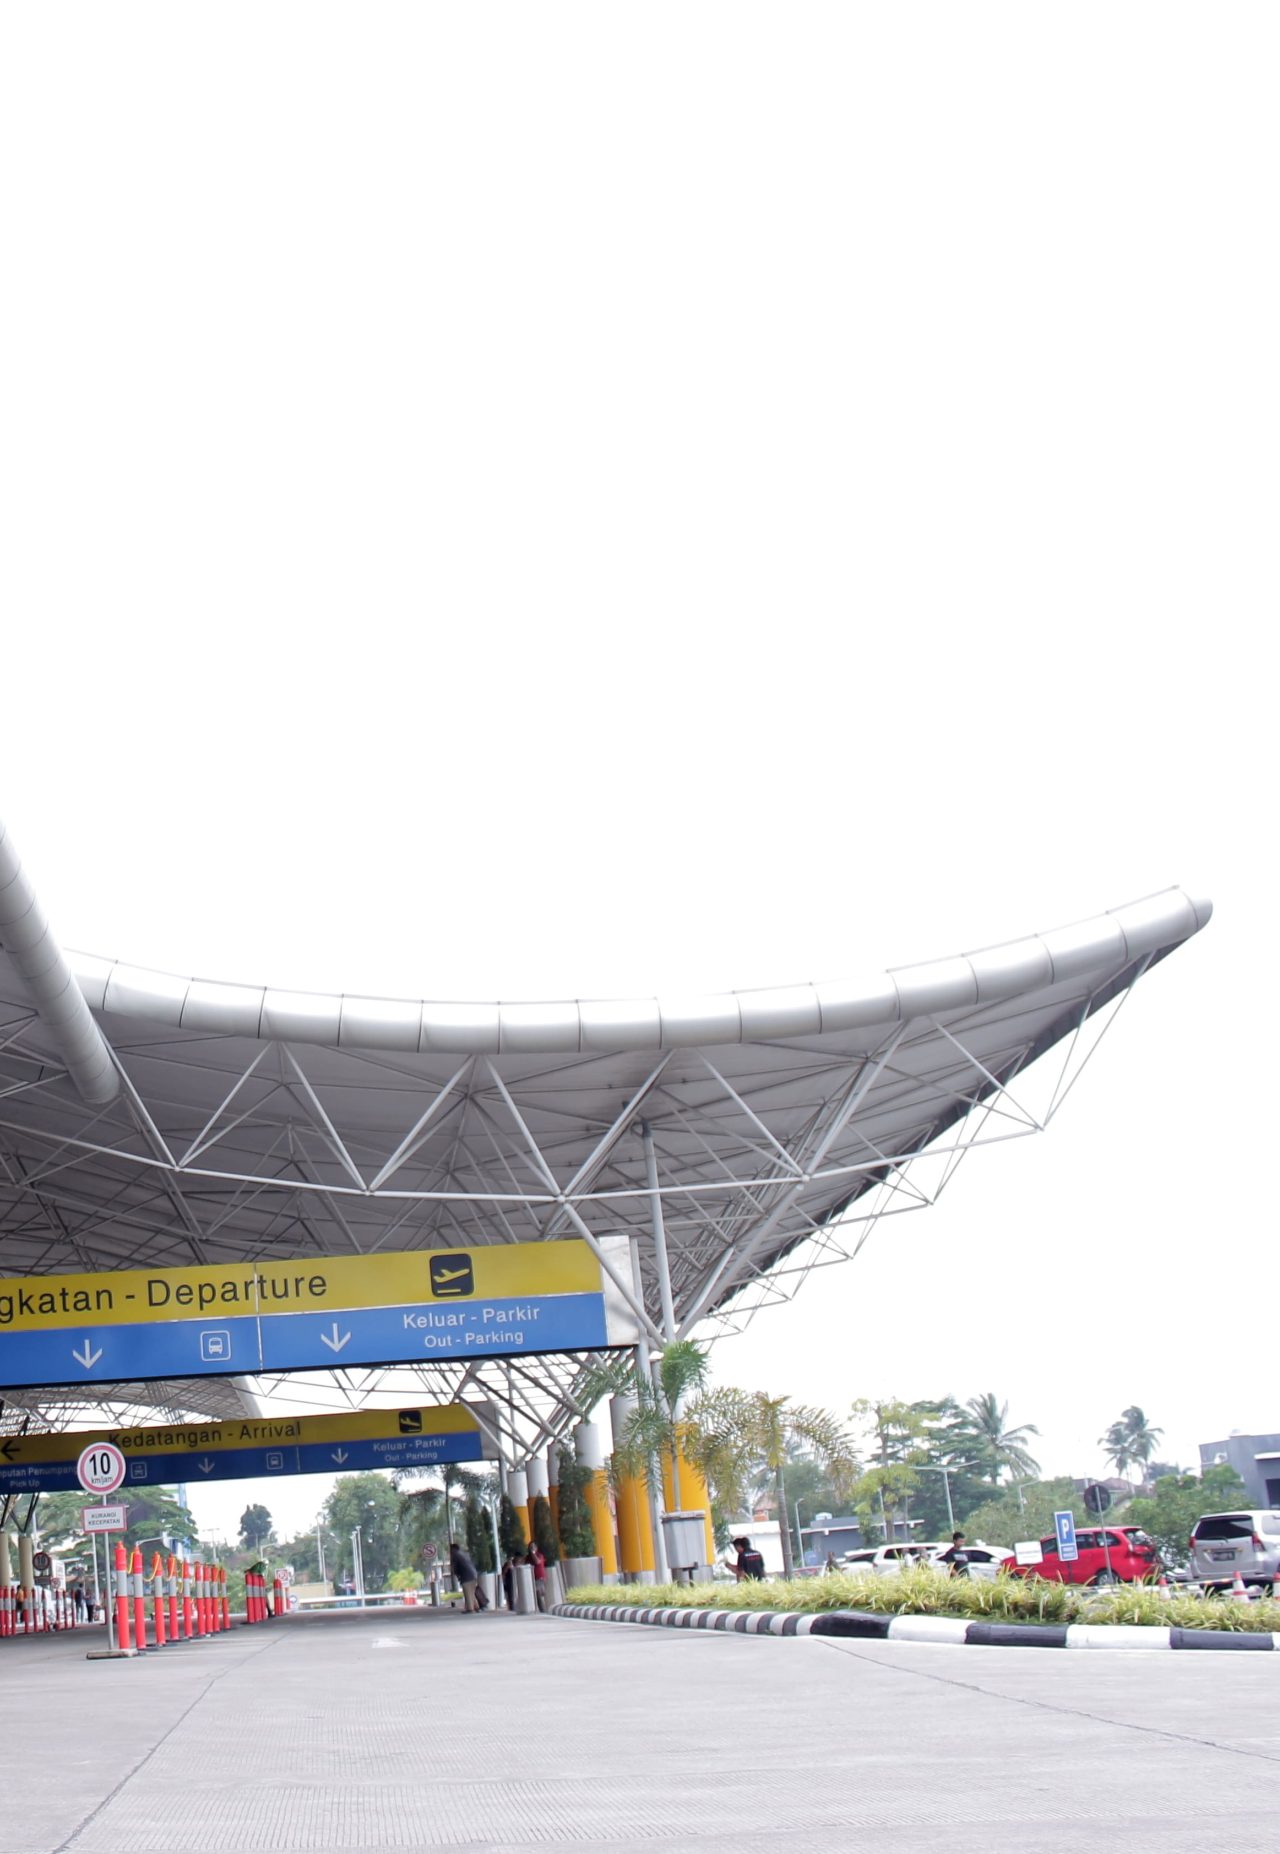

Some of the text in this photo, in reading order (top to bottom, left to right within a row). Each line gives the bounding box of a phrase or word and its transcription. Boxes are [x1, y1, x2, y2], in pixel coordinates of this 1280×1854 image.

[147, 1274, 328, 1311] Departure
[403, 1312, 466, 1329] Keluar
[482, 1305, 540, 1324] Parkir
[424, 1334, 453, 1348] Out
[465, 1330, 524, 1345] Parking
[107, 1427, 222, 1448] Kedatangan
[239, 1420, 302, 1441] Arrival
[373, 1442, 407, 1452] Keluar
[415, 1438, 446, 1449] Parkir
[89, 1452, 111, 1476] 10
[384, 1453, 400, 1462] Out
[406, 1451, 438, 1461] Parking
[88, 1518, 121, 1526] KECEPATAN
[1061, 1518, 1070, 1539] P
